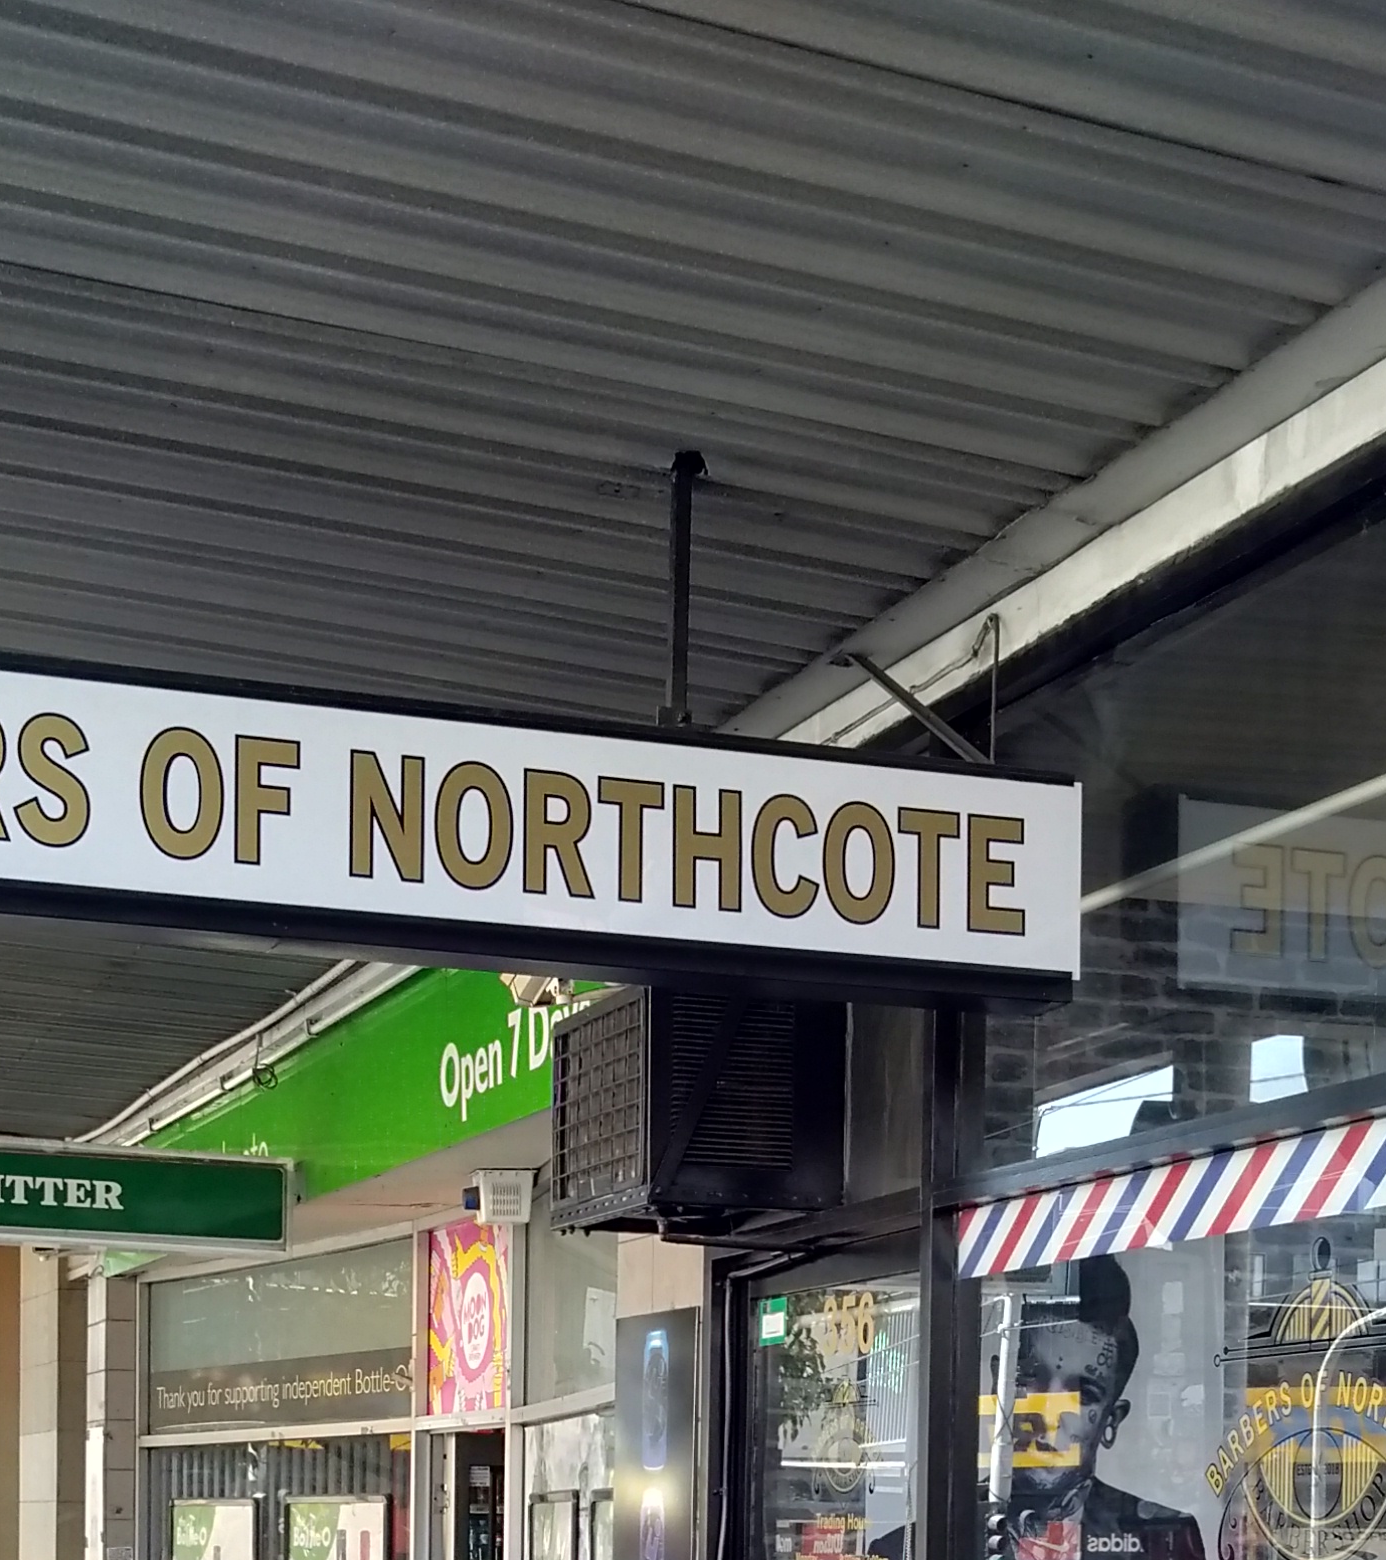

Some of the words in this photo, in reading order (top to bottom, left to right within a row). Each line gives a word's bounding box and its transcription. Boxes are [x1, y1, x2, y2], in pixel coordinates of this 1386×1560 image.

[139, 726, 301, 865] OF
[349, 749, 1026, 935] NORTHCOTE
[440, 1038, 502, 1121] Open
[508, 1011, 523, 1078] 7
[823, 1291, 874, 1354] 356
[156, 1385, 186, 1410] Thank
[187, 1388, 205, 1413] you
[207, 1382, 222, 1406] for
[224, 1377, 280, 1409] supporting
[282, 1370, 352, 1405] independent
[1205, 1381, 1292, 1497] BARBERS
[816, 1513, 845, 1534] Trading
